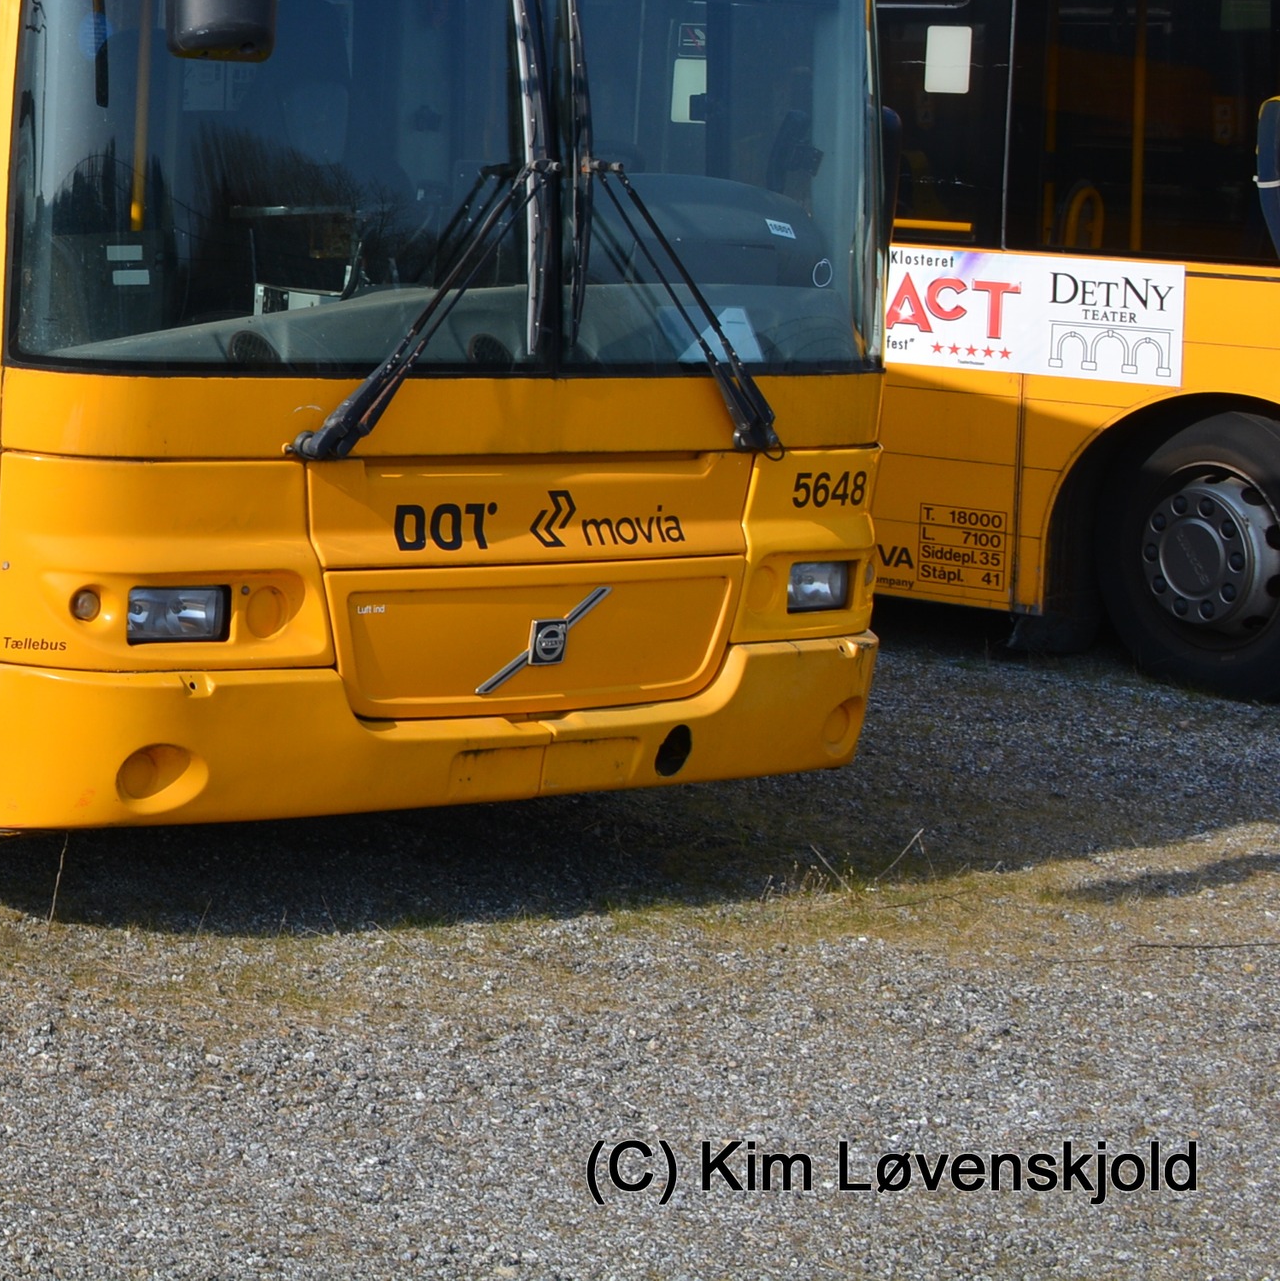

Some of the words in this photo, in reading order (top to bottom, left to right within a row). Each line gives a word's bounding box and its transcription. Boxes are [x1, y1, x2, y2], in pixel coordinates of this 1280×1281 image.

[890, 250, 954, 267] Klosteret
[886, 271, 1022, 339] ACT
[1082, 309, 1138, 323] TEATER
[792, 471, 867, 508] 5648
[394, 502, 498, 551] DOT
[581, 505, 686, 546] movia
[923, 507, 935, 521] T.
[950, 510, 1002, 528] 18000
[922, 527, 935, 541] L.
[962, 531, 1001, 548] 7100
[921, 545, 977, 565] Siddepl.
[980, 552, 1000, 566] 35
[921, 564, 964, 583] Ståpl.
[981, 573, 1000, 586] 41
[3, 637, 67, 651] Tællebus
